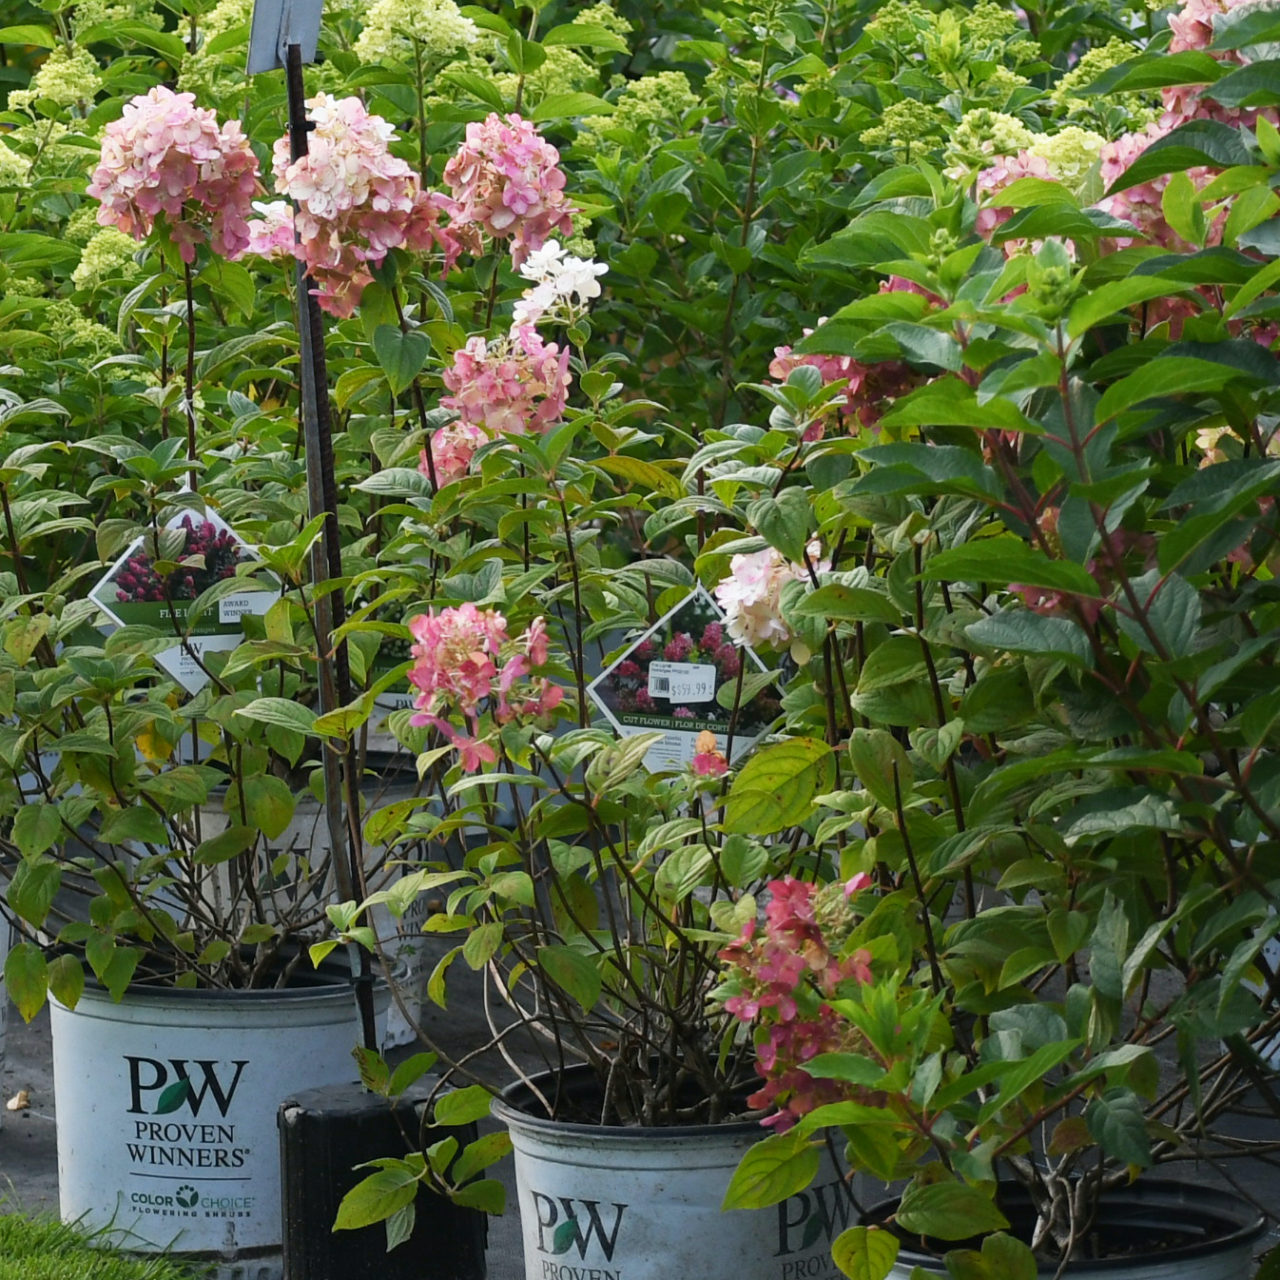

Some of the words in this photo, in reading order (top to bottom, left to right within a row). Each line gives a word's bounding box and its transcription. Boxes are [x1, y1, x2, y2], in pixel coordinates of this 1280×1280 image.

[223, 599, 249, 608] AWARD
[623, 715, 639, 724] CUT
[639, 717, 670, 727] FLOWER
[674, 720, 695, 729] FLOR
[695, 722, 706, 730] DE
[122, 1055, 251, 1118] PW
[135, 1120, 236, 1144] PROVEN
[130, 1193, 174, 1207] COLOR
[131, 1206, 198, 1218] FLOWERING
[530, 1189, 629, 1263] PW
